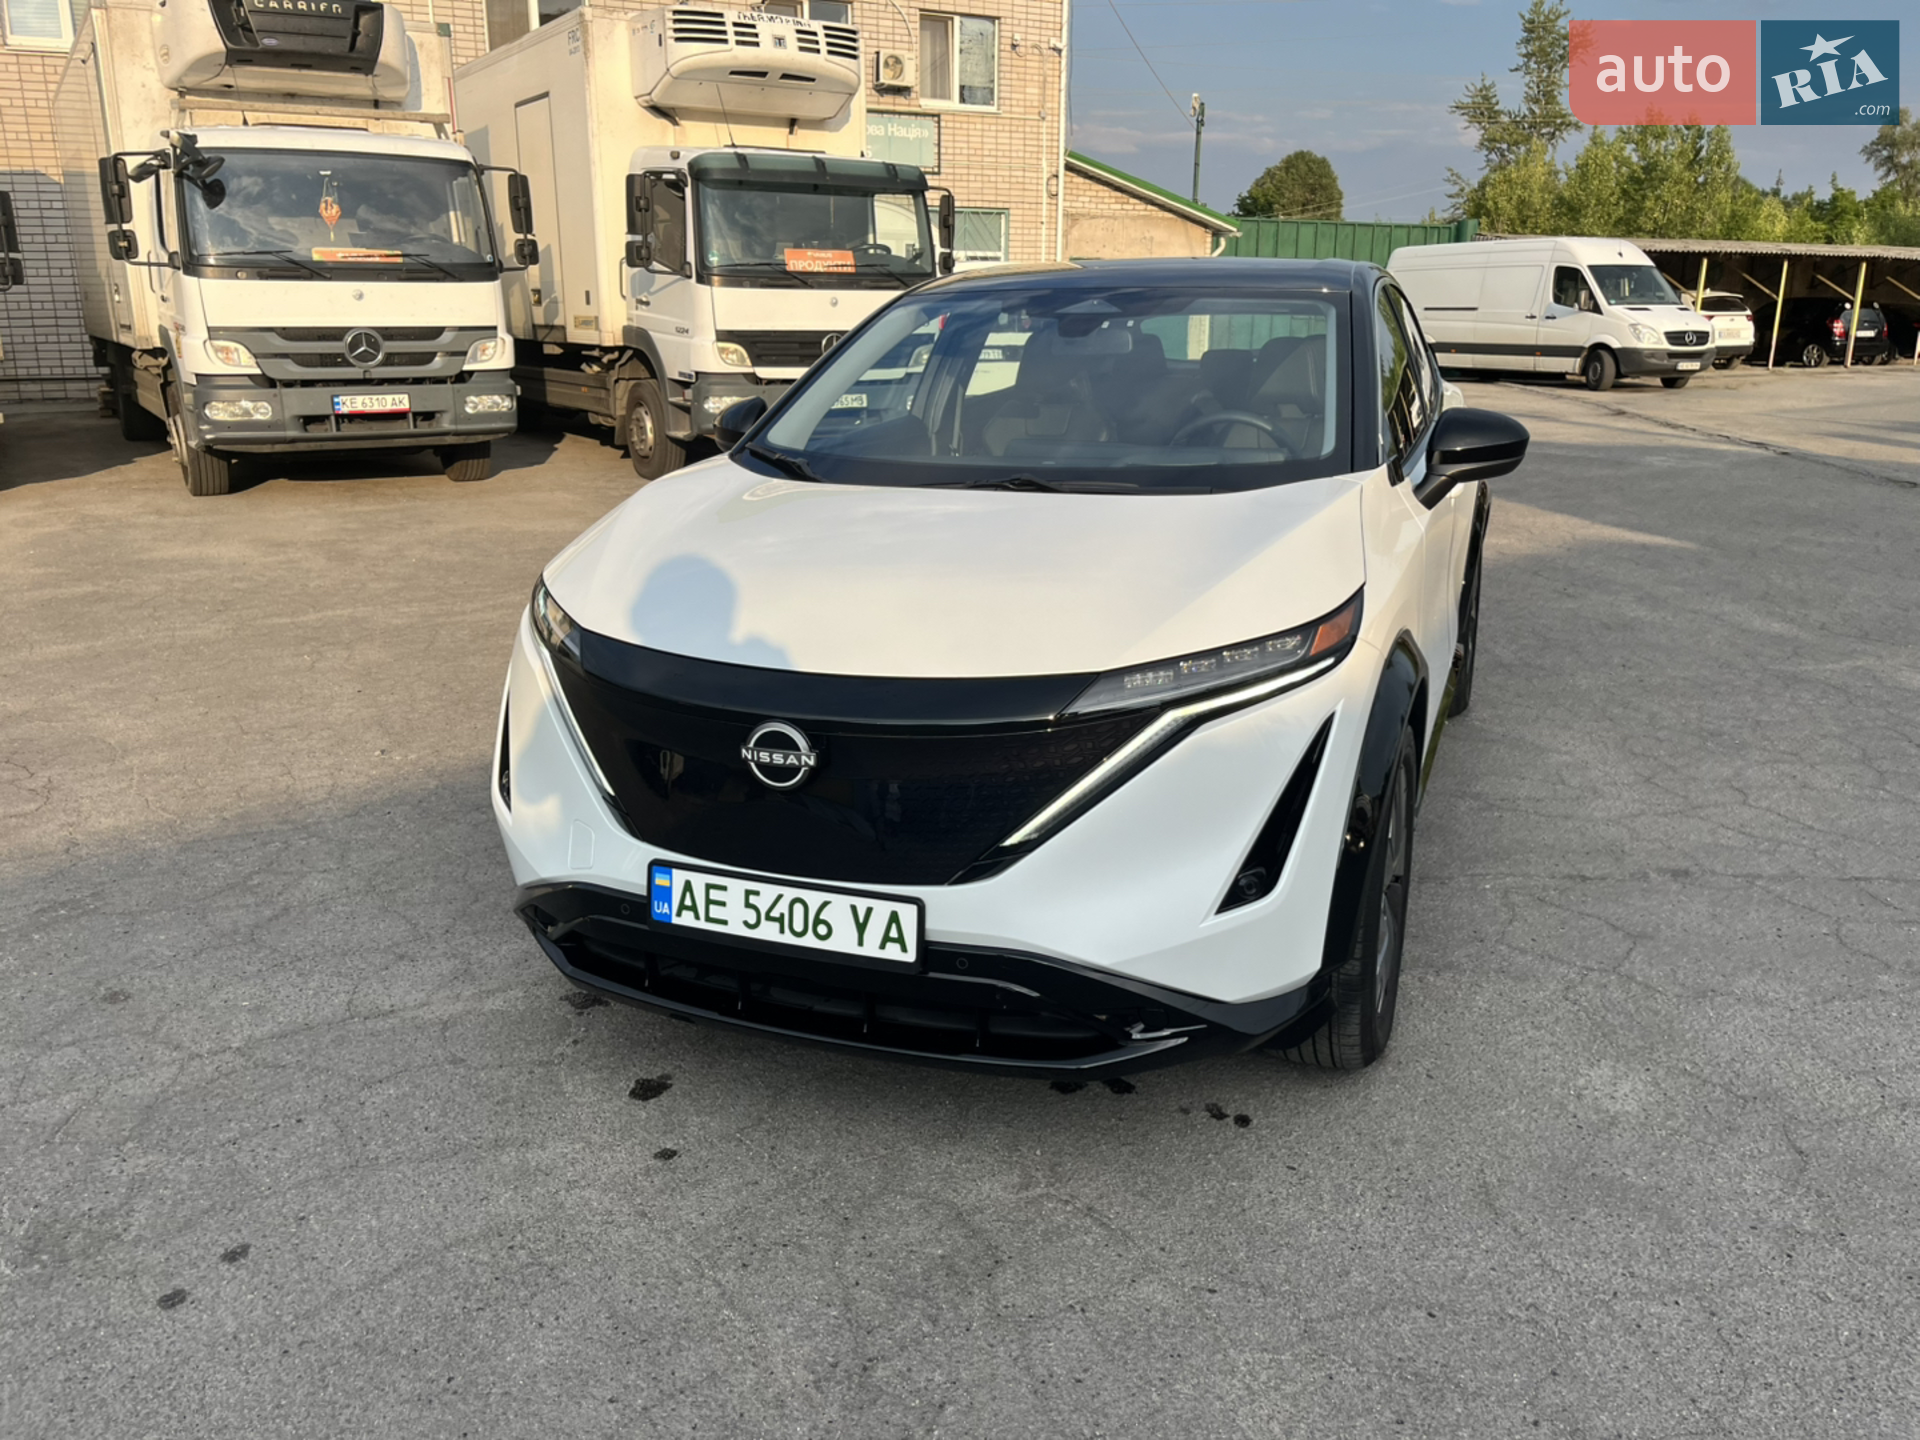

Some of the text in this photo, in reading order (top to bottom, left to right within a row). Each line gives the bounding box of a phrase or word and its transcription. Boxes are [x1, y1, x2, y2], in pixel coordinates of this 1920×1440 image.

[341, 396, 406, 408] KE 6310 AK
[741, 748, 815, 766] NISSAN
[654, 900, 670, 915] UA
[675, 879, 908, 953] AE 5406 YA
